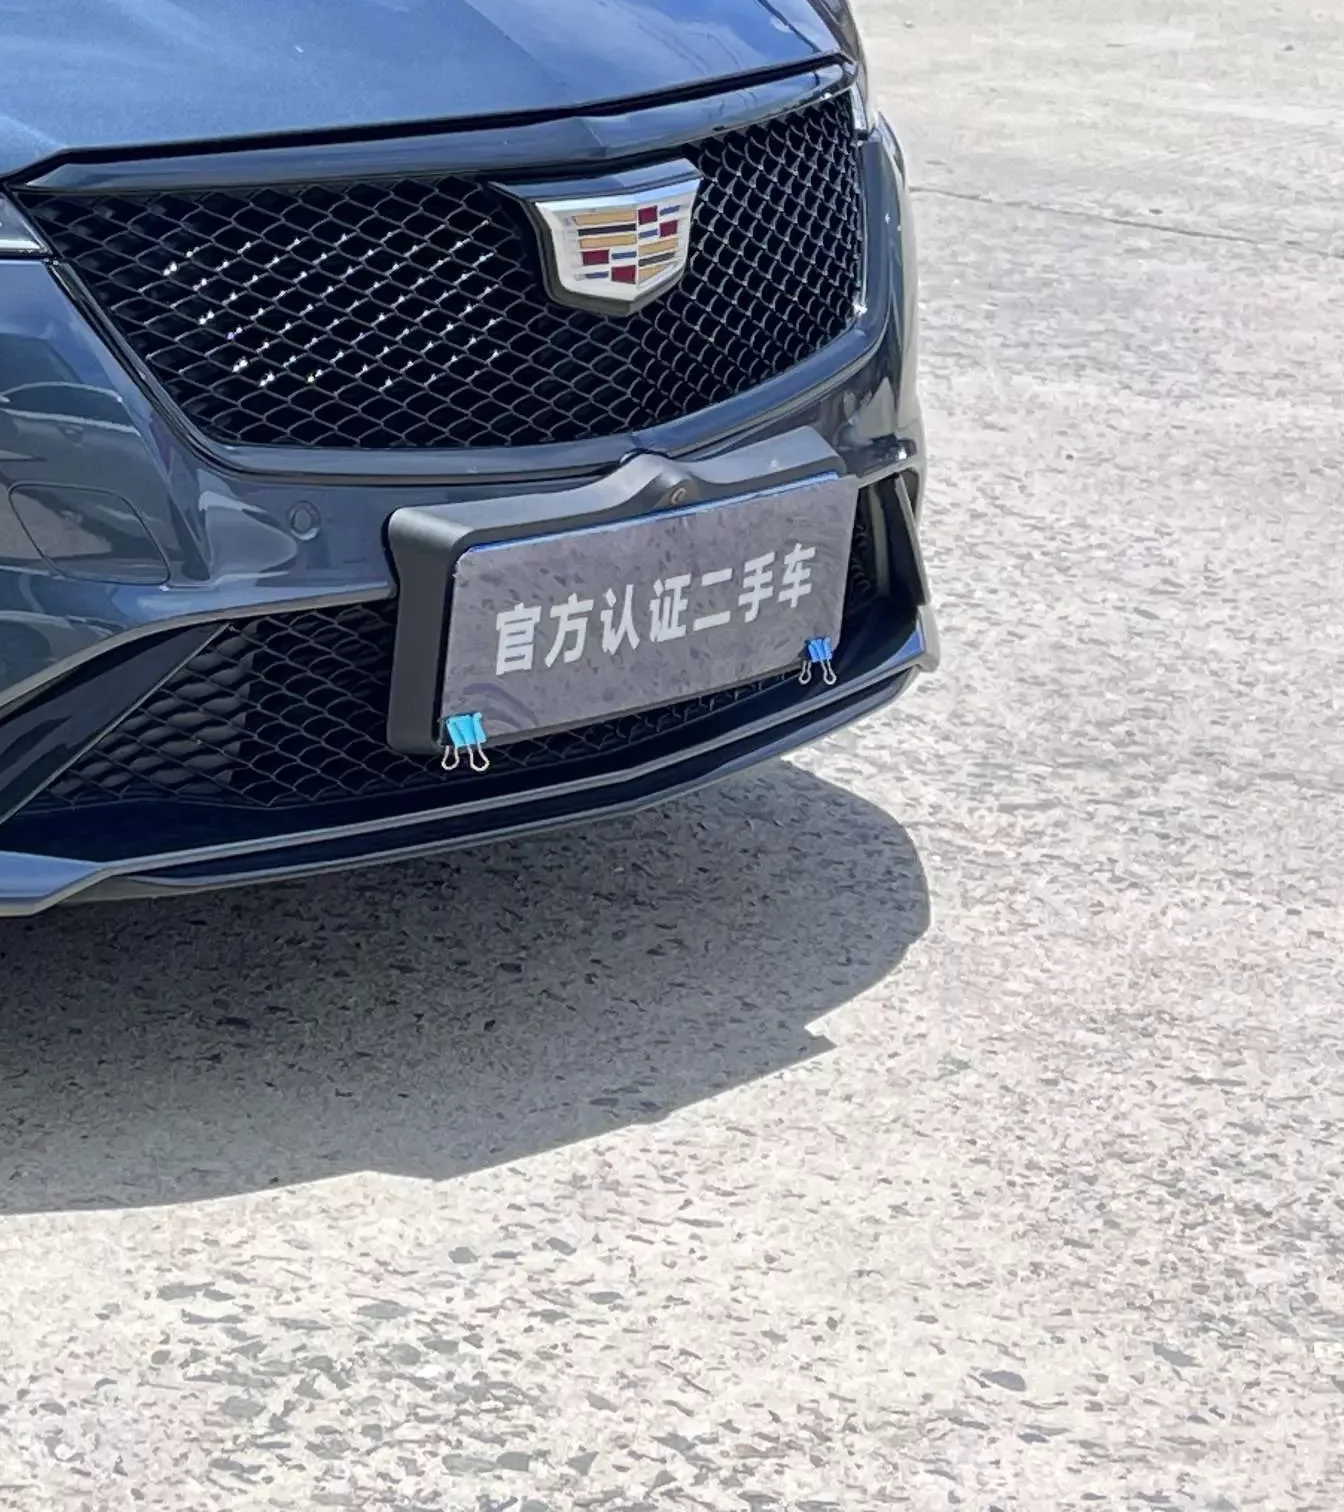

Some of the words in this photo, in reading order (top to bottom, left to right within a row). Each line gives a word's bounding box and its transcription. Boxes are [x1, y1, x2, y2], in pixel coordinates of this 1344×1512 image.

[495, 542, 816, 676] 官方认证二手车
